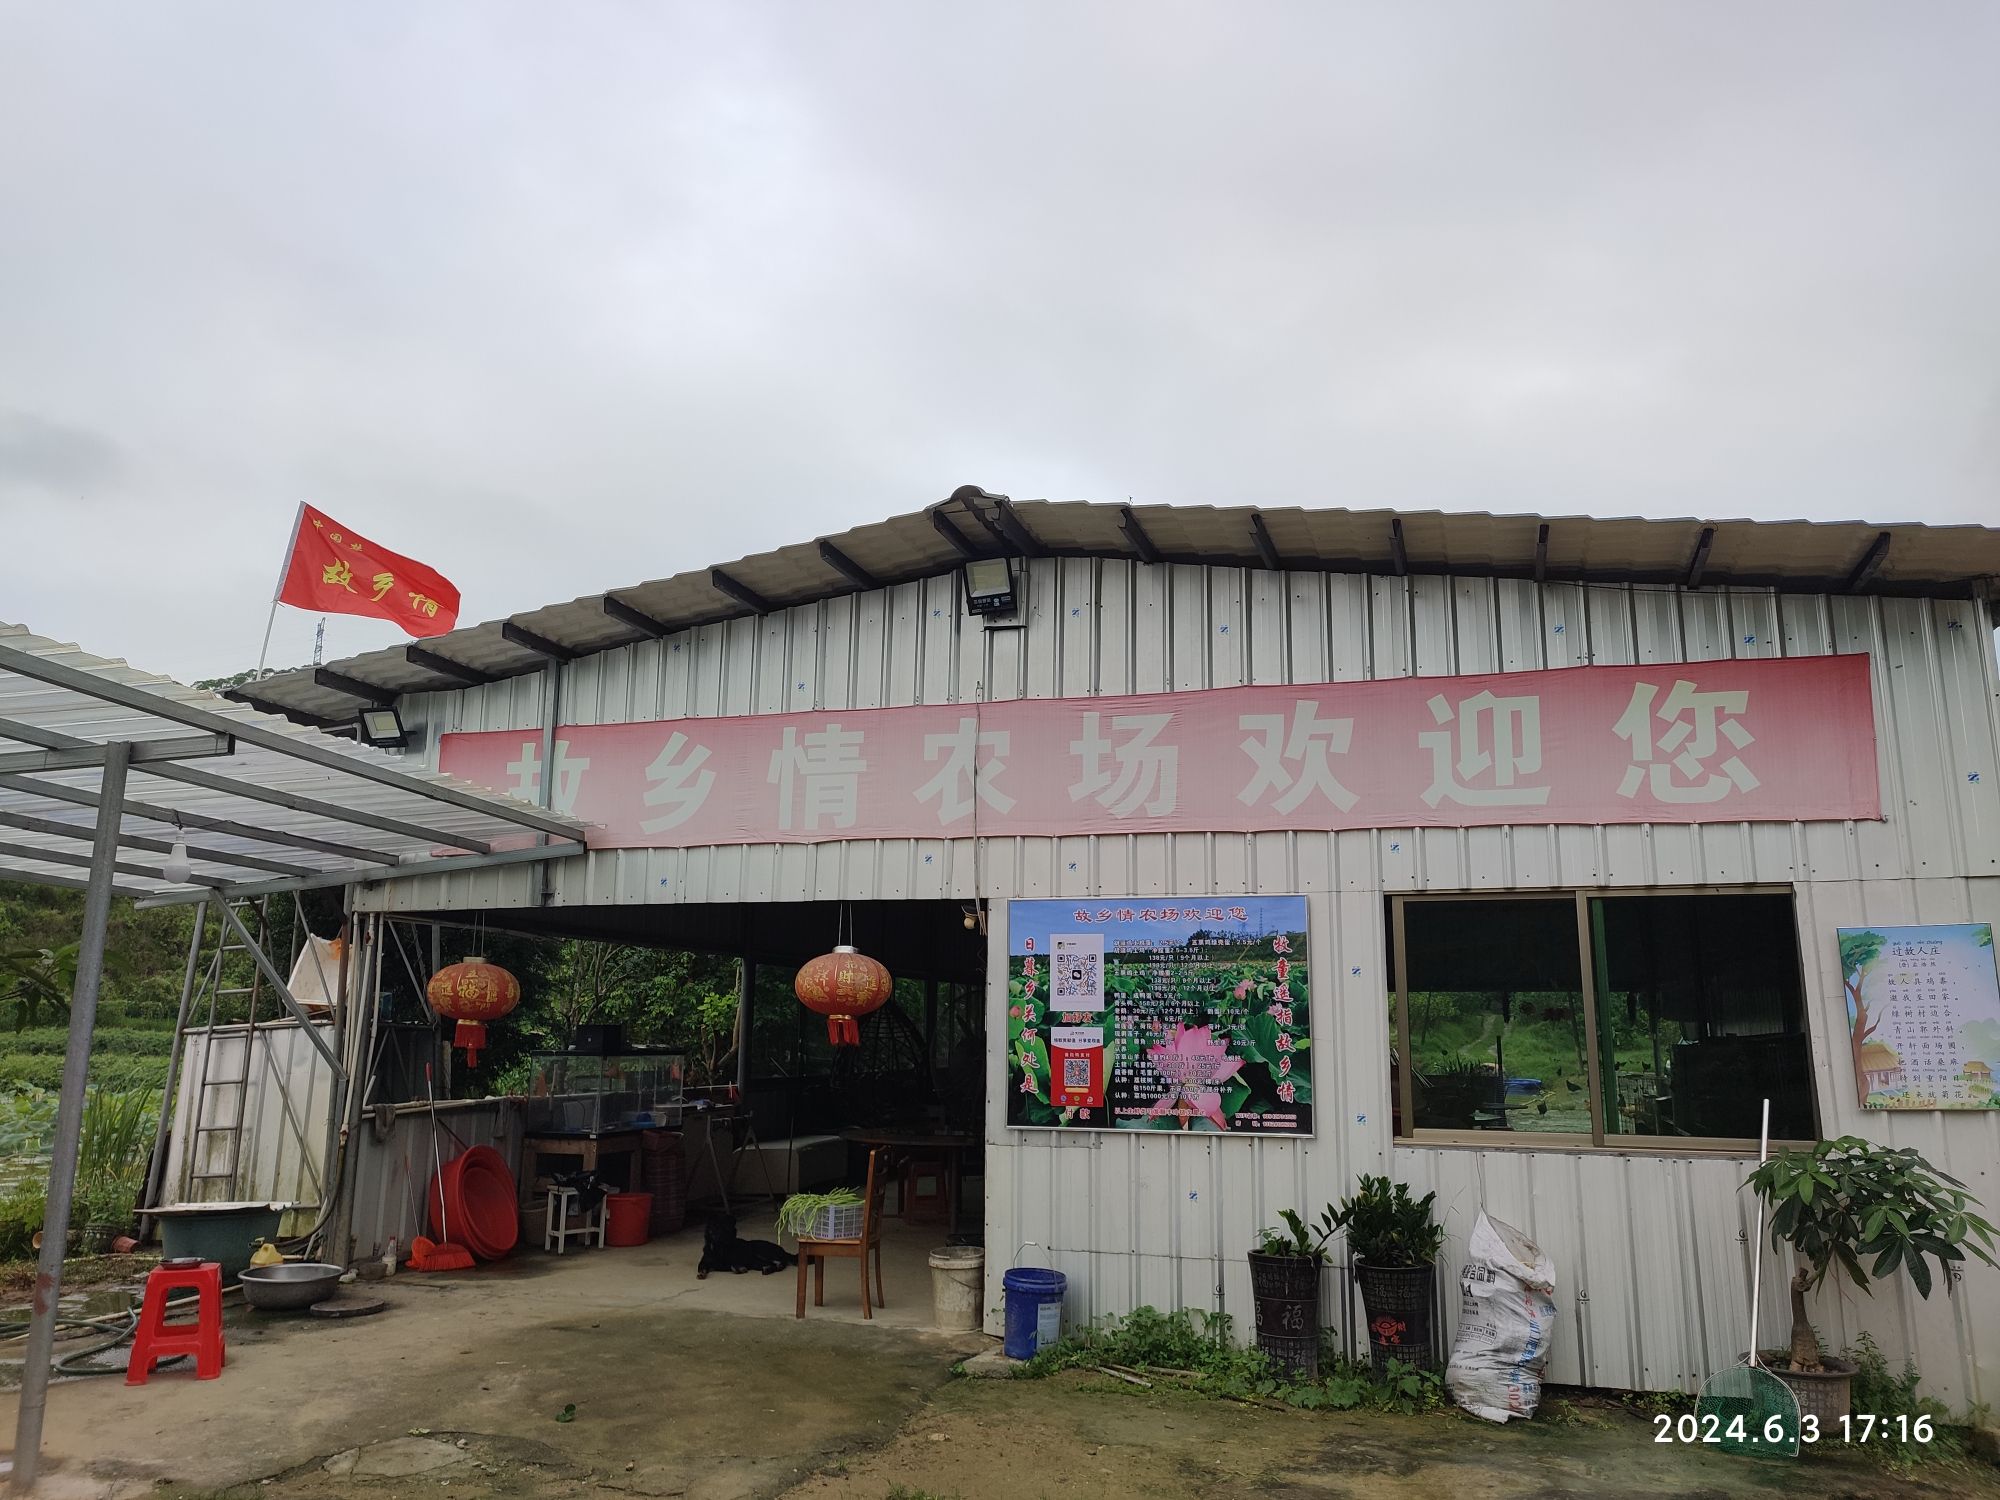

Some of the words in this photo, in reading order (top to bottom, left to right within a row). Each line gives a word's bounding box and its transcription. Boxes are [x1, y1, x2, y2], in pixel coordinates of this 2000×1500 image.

[506, 679, 1761, 835] 故乡情农场欢迎您
[1073, 907, 1249, 923] 故乡情农场欢迎您
[1891, 946, 1941, 957] 过故人庄
[1021, 937, 1040, 1093] 日暮乡关何处是
[1272, 935, 1295, 1104] 牧童遥指故乡情
[1281, 1304, 1304, 1331] 福
